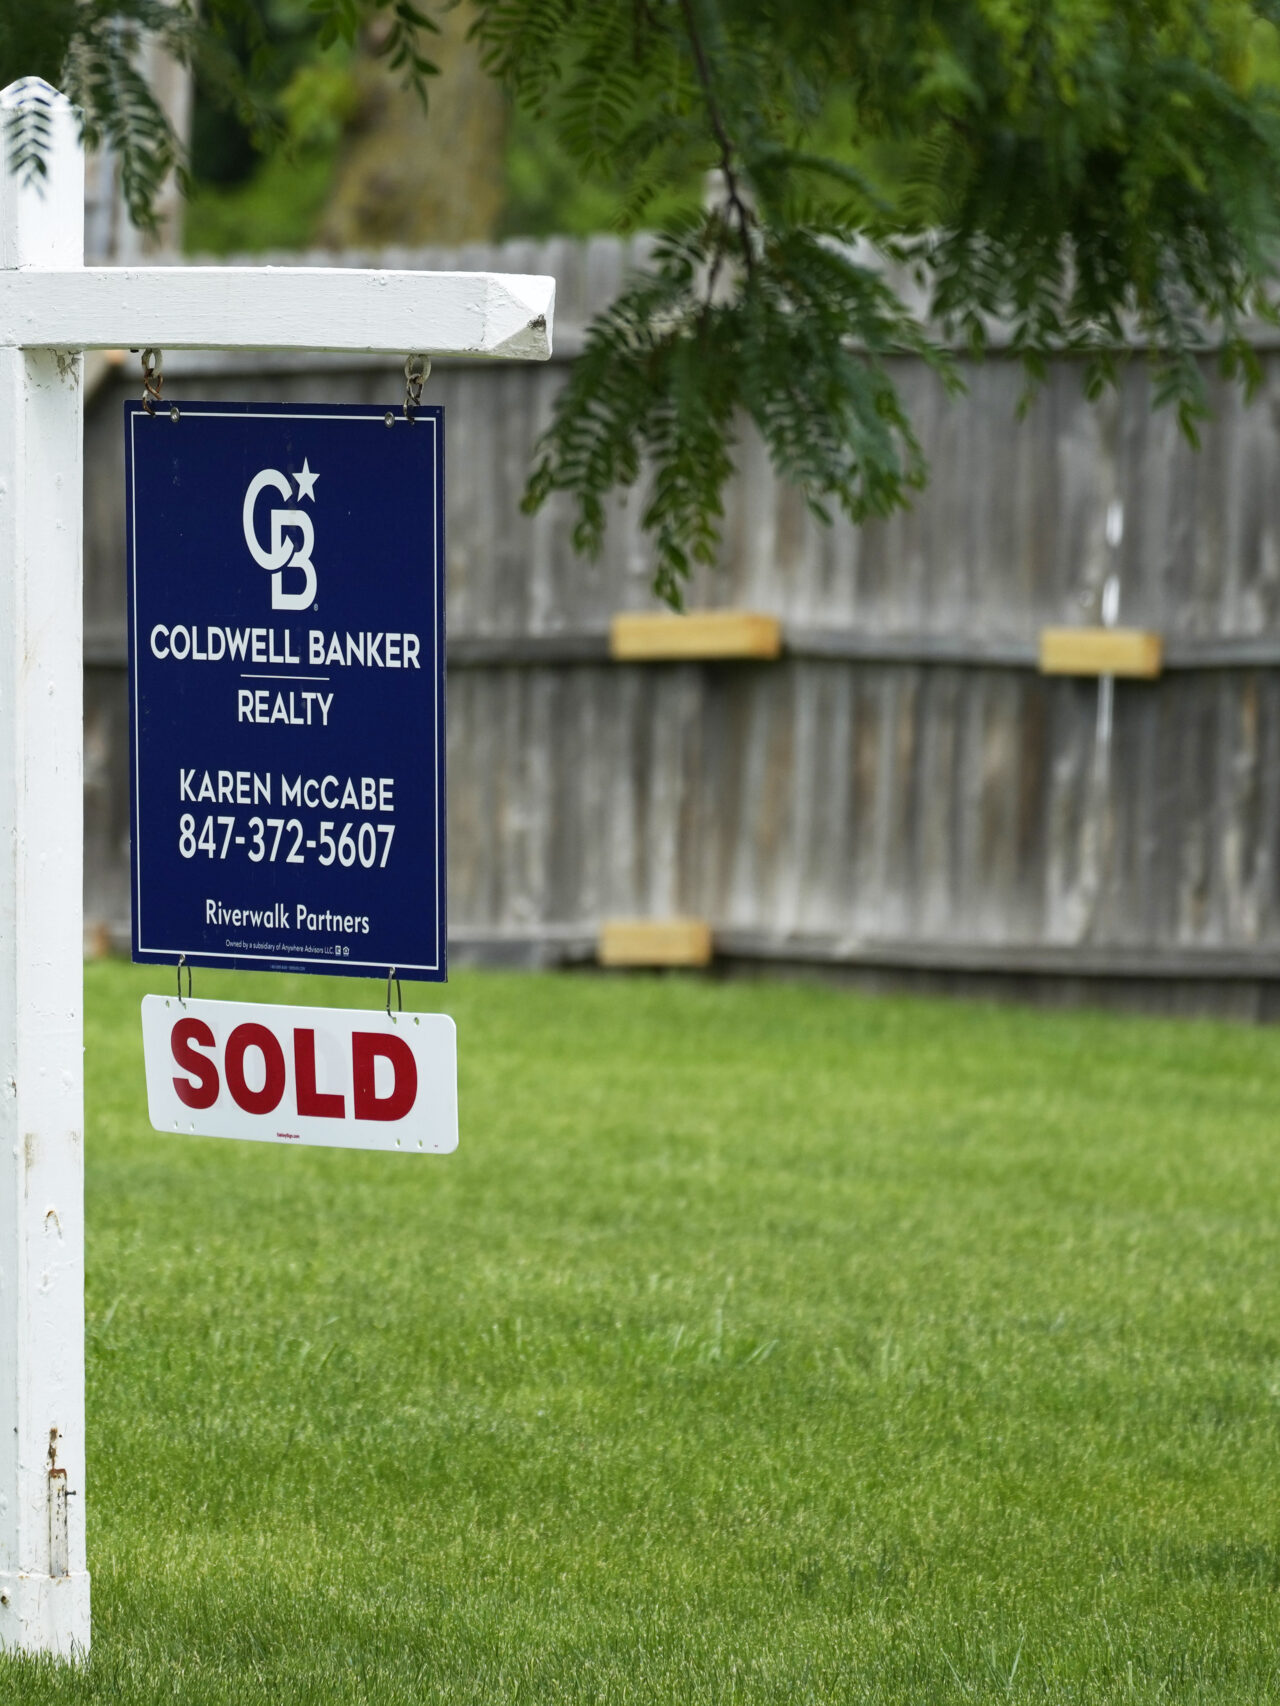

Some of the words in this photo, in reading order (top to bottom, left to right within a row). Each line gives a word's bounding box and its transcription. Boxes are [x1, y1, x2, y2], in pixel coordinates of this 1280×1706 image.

[150, 623, 300, 664] COLDWELL
[308, 629, 421, 669] BANKER
[238, 689, 334, 726] REALTY
[180, 768, 271, 805] KAREN
[281, 774, 395, 812] McCABE
[178, 813, 396, 869] 847-372-5607
[206, 899, 290, 929] Riverwalk
[296, 904, 370, 934] Partners
[225, 939, 242, 948] Owned
[242, 940, 249, 950] by
[253, 941, 275, 951] subsidiary
[275, 942, 282, 951] of
[281, 943, 304, 953] Anywhere
[170, 1017, 418, 1122] SOLD
